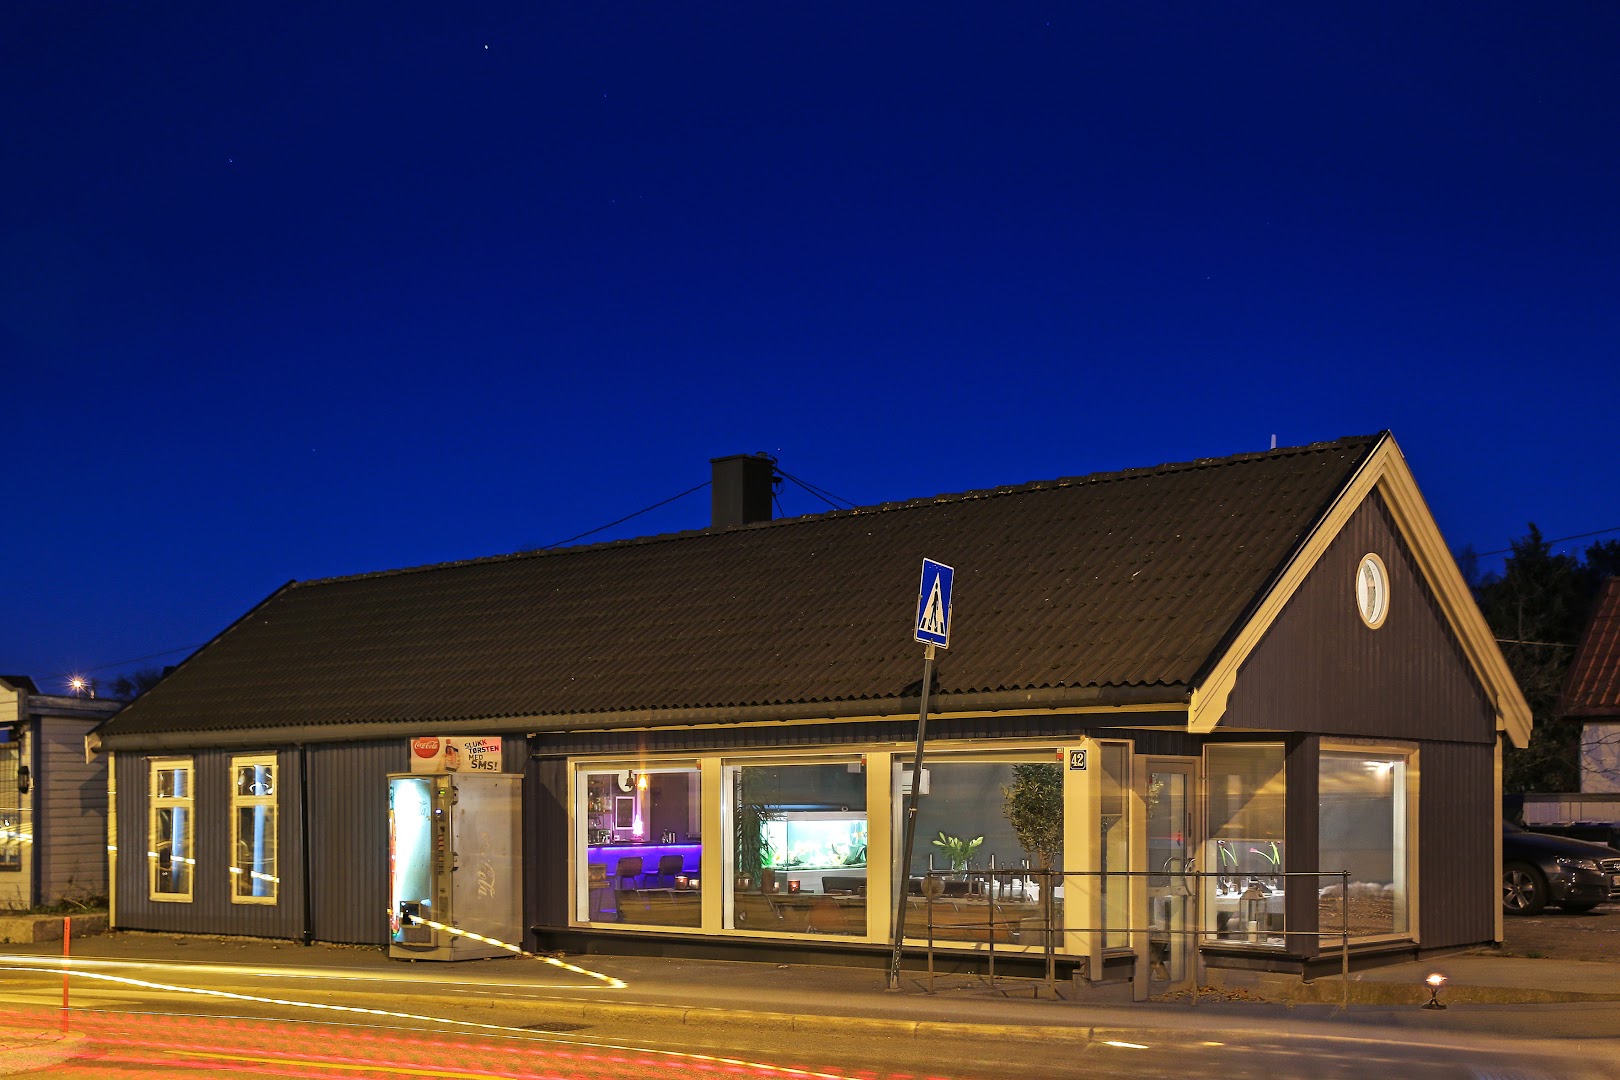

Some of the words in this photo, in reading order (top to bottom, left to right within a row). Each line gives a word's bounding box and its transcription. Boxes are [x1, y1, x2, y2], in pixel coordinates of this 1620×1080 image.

[464, 739, 487, 749] SLUKK
[469, 745, 499, 754] TØRSTEN
[1071, 753, 1084, 766] 42
[471, 760, 498, 771] SMS!
